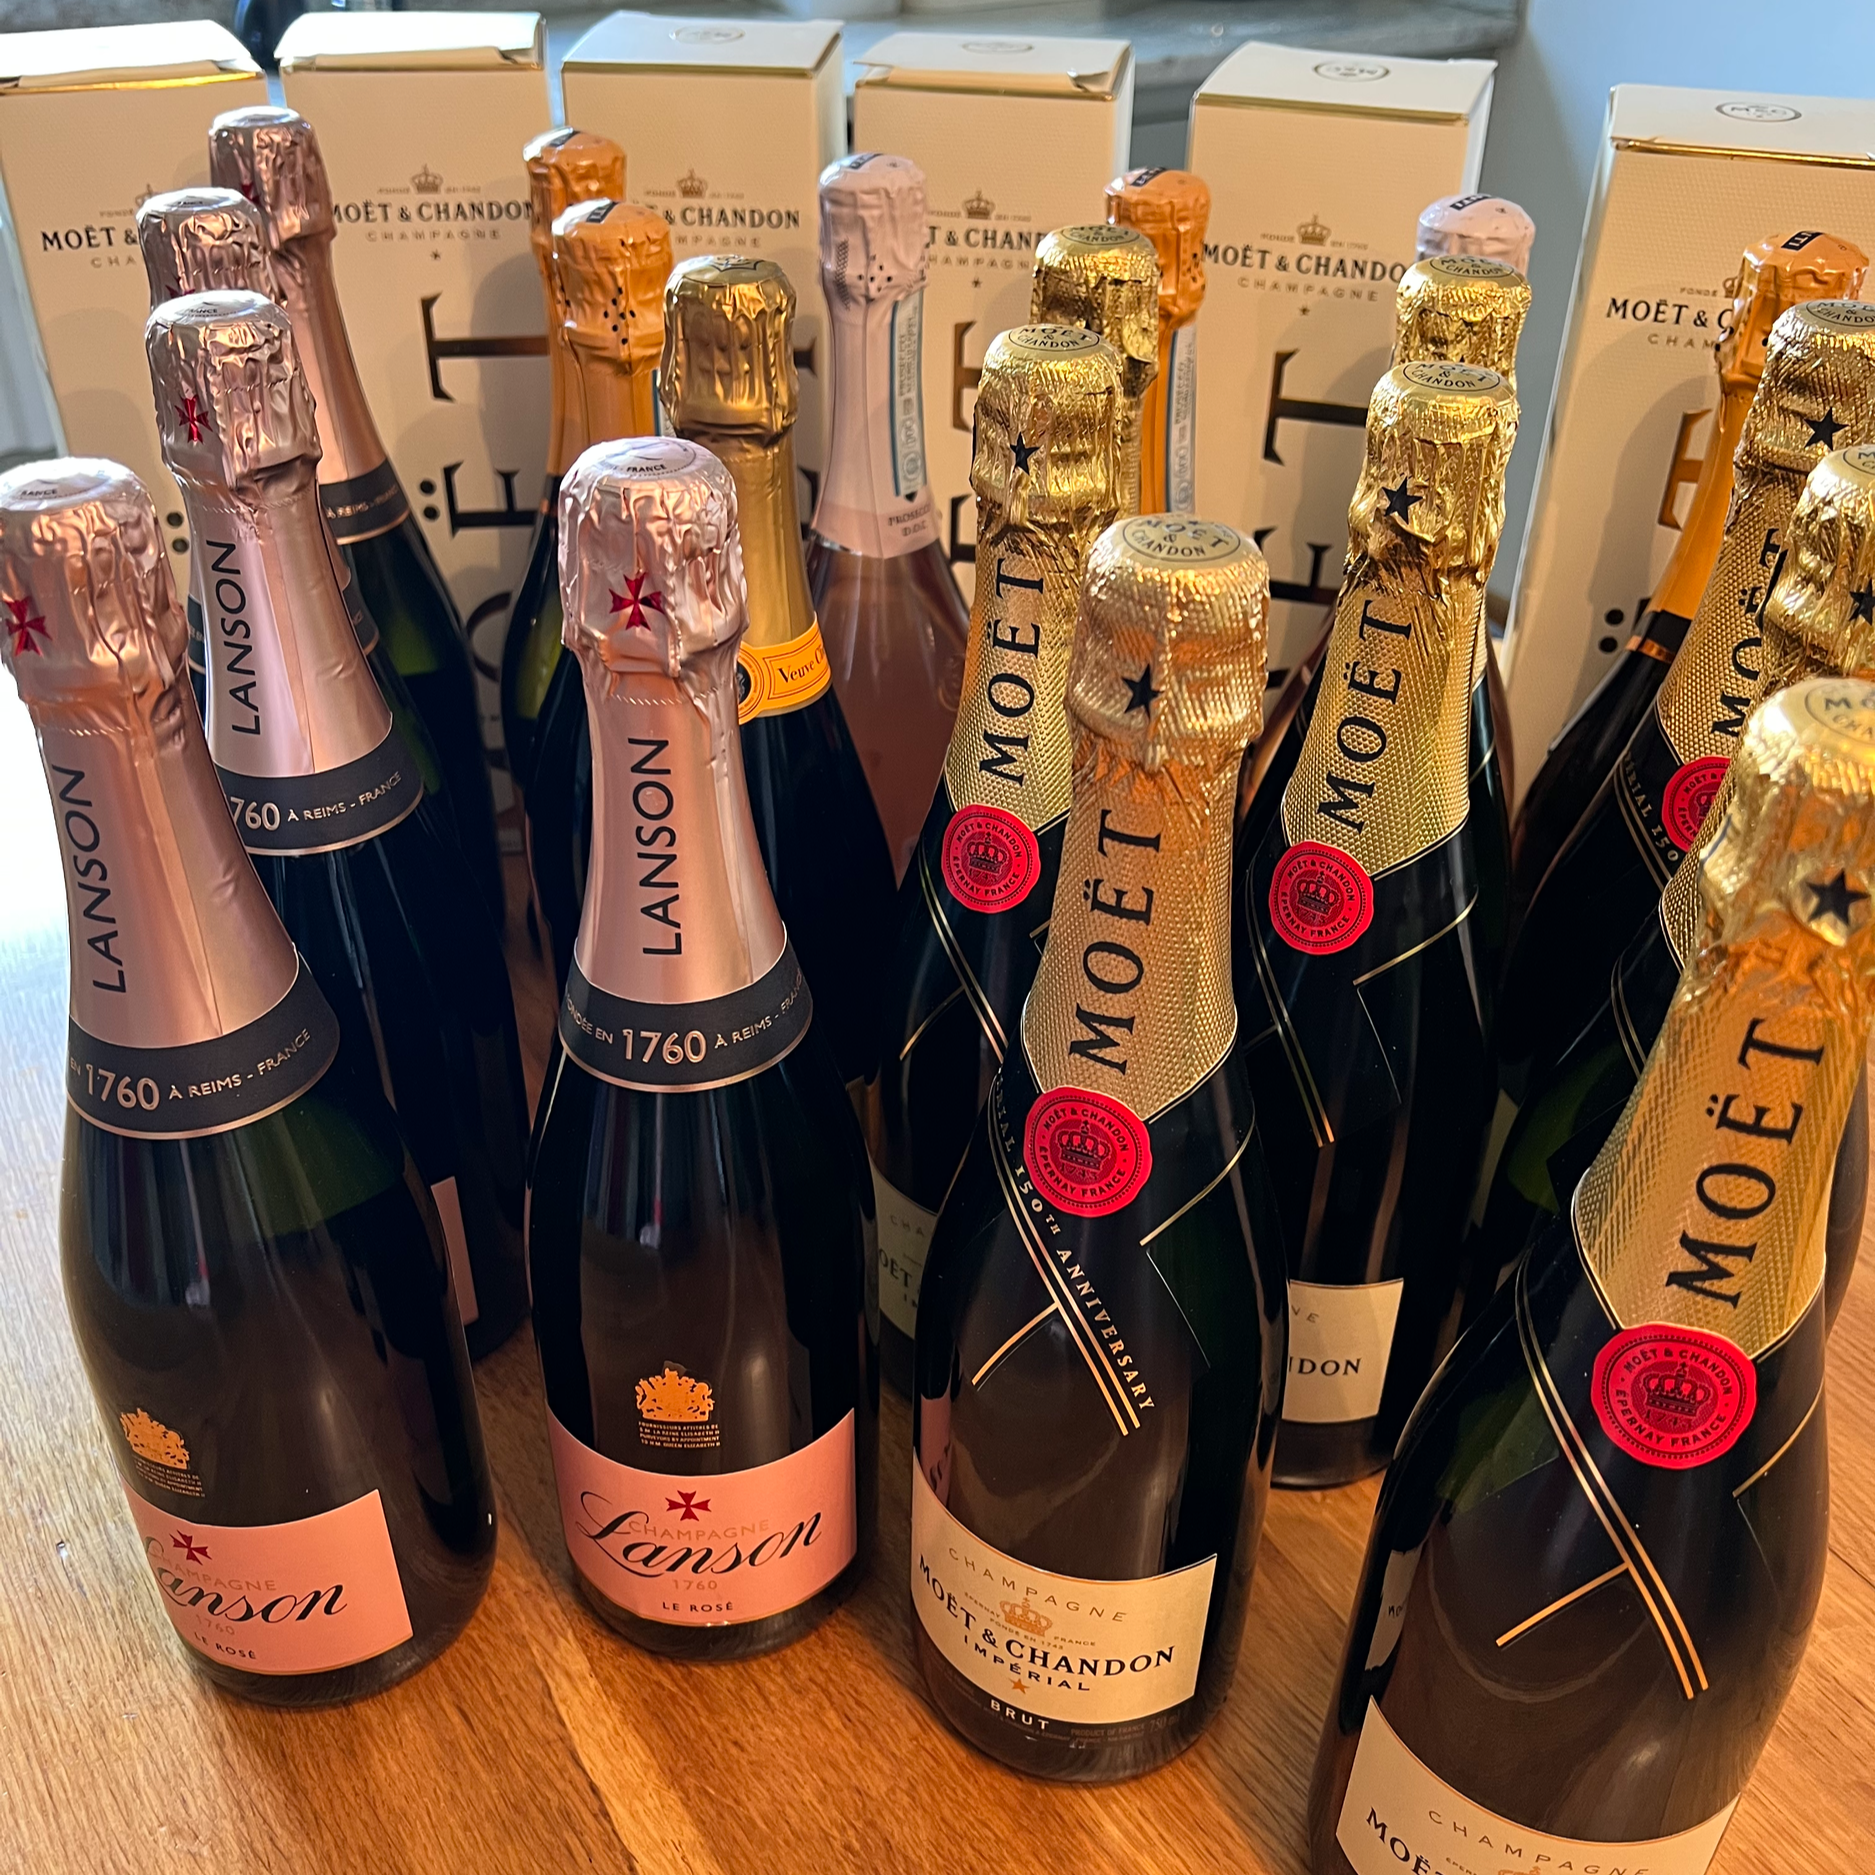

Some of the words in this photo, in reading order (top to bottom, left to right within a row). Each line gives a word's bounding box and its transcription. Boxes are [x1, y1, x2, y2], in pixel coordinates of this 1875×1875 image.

[398, 205, 412, 222] &
[664, 209, 676, 226] &
[680, 207, 800, 229] CHANDON
[41, 224, 116, 252] MOËT
[124, 228, 138, 246] &
[675, 235, 761, 248] MPAGNE
[944, 230, 959, 247] &
[929, 252, 1030, 270] HAMPAGN
[1275, 255, 1290, 272] &
[1295, 252, 1407, 284] CHANDO
[1238, 276, 1379, 302] CHAMPAGNE
[1606, 297, 1689, 326] MOËT
[1693, 310, 1708, 328] &
[1817, 307, 1875, 324] CHANDO
[1017, 334, 1080, 349] CHANDON
[1411, 369, 1476, 388] CHANDON
[626, 463, 667, 473] FRANCE
[20, 488, 58, 498] RANCE
[1131, 529, 1207, 557] CHANDON
[1163, 534, 1178, 543] &
[205, 538, 261, 736] LANSON
[777, 660, 816, 684] Veuve
[978, 558, 1044, 788] MOËT
[1315, 600, 1413, 833] MOËT
[230, 796, 281, 832] 760
[303, 801, 348, 821] REIMS
[358, 771, 402, 807] FRANCE
[627, 737, 683, 957] LANSON
[985, 821, 1022, 859] CHANDON
[52, 764, 127, 994] LANSON
[984, 871, 1020, 897] FRANCE
[1318, 860, 1356, 902] CHANDON
[1310, 915, 1350, 938] FRANCE
[1068, 809, 1162, 1077] MOËT
[565, 992, 593, 1037] ONDÉE
[595, 1028, 614, 1045] EN
[622, 1027, 707, 1065] 1760
[714, 1033, 728, 1050] À
[731, 1015, 773, 1044] REIMS
[84, 1063, 161, 1111] 1760
[168, 1084, 184, 1101] À
[188, 1073, 243, 1098] REIMS
[257, 1028, 312, 1076] FRANCE
[1081, 1108, 1129, 1152] CHANDON
[1664, 1016, 1825, 1310] MOËT
[1081, 1168, 1127, 1198] FRANCE
[1056, 1247, 1155, 1411] ANNIVERSARY
[1623, 1348, 1658, 1374] MOËT
[1678, 1348, 1733, 1396] CHANDON
[1670, 1413, 1727, 1447] FRANCE
[574, 1490, 823, 1578] Lanson
[626, 1518, 771, 1542] CHAMPAGNE
[672, 1578, 719, 1592] 1760
[948, 1547, 1128, 1623] CHAMPAGNE
[662, 1601, 681, 1612] LE
[689, 1600, 735, 1613] ROSÉ
[919, 1553, 977, 1631] MOËT
[981, 1627, 999, 1649] &
[1005, 1638, 1176, 1679] CHANDON
[194, 1631, 209, 1646] LE
[1023, 1634, 1037, 1643] EN
[1040, 1640, 1064, 1650] 1743
[1053, 1636, 1097, 1647] FRANCE
[963, 1634, 1091, 1692] IMPÉRIAL
[989, 1699, 1050, 1730] BRUT
[1070, 1727, 1105, 1737] PRODUCT
[1365, 1806, 1445, 1875] MOË
[1428, 1808, 1650, 1875] CHAMPAGNE
